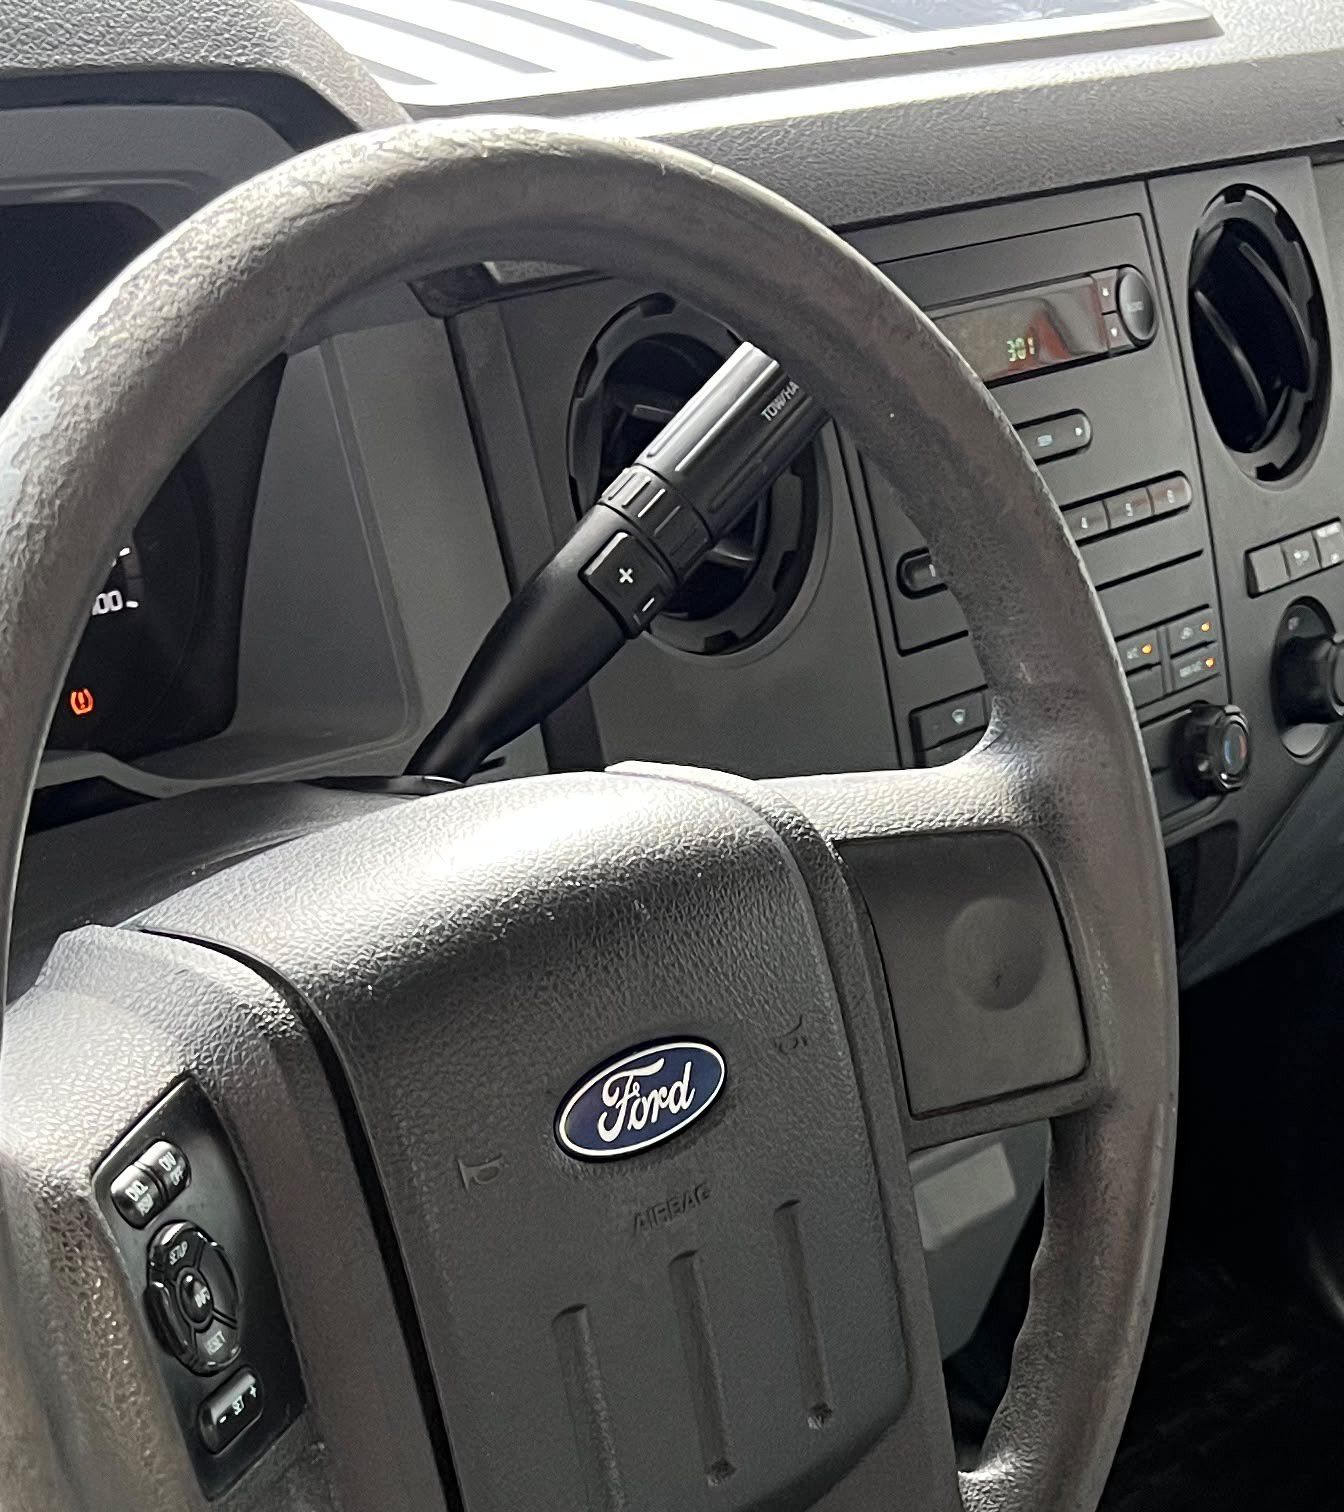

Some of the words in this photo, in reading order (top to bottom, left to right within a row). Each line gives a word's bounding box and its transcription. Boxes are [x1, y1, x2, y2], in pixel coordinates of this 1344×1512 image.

[760, 381, 800, 421] TOW/HA
[597, 1057, 696, 1143] Ford
[631, 1182, 712, 1238] AIRBAG
